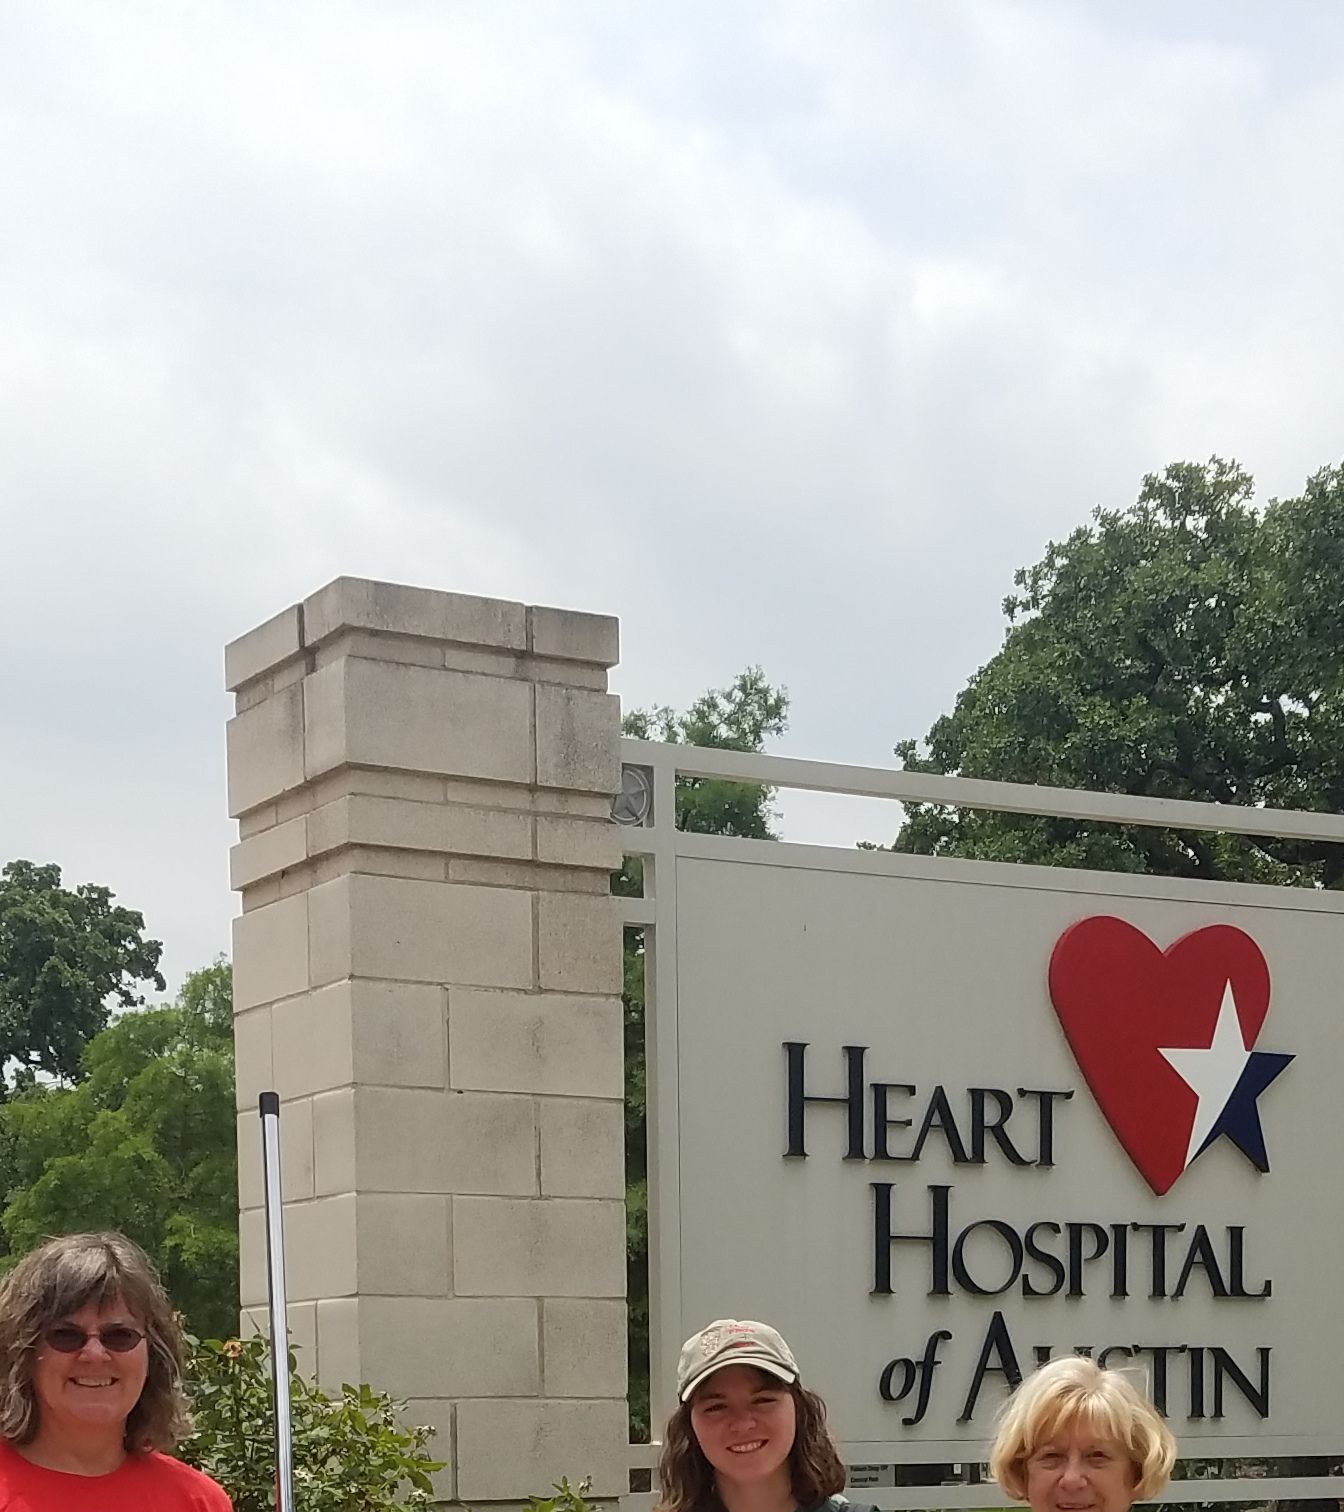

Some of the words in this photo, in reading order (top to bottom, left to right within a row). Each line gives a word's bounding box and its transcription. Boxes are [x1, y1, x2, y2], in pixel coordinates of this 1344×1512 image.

[782, 1042, 1074, 1166] HEART
[869, 1183, 1272, 1298] HOSPITAL
[879, 1330, 952, 1425] of
[956, 1311, 1272, 1424] ATIN
